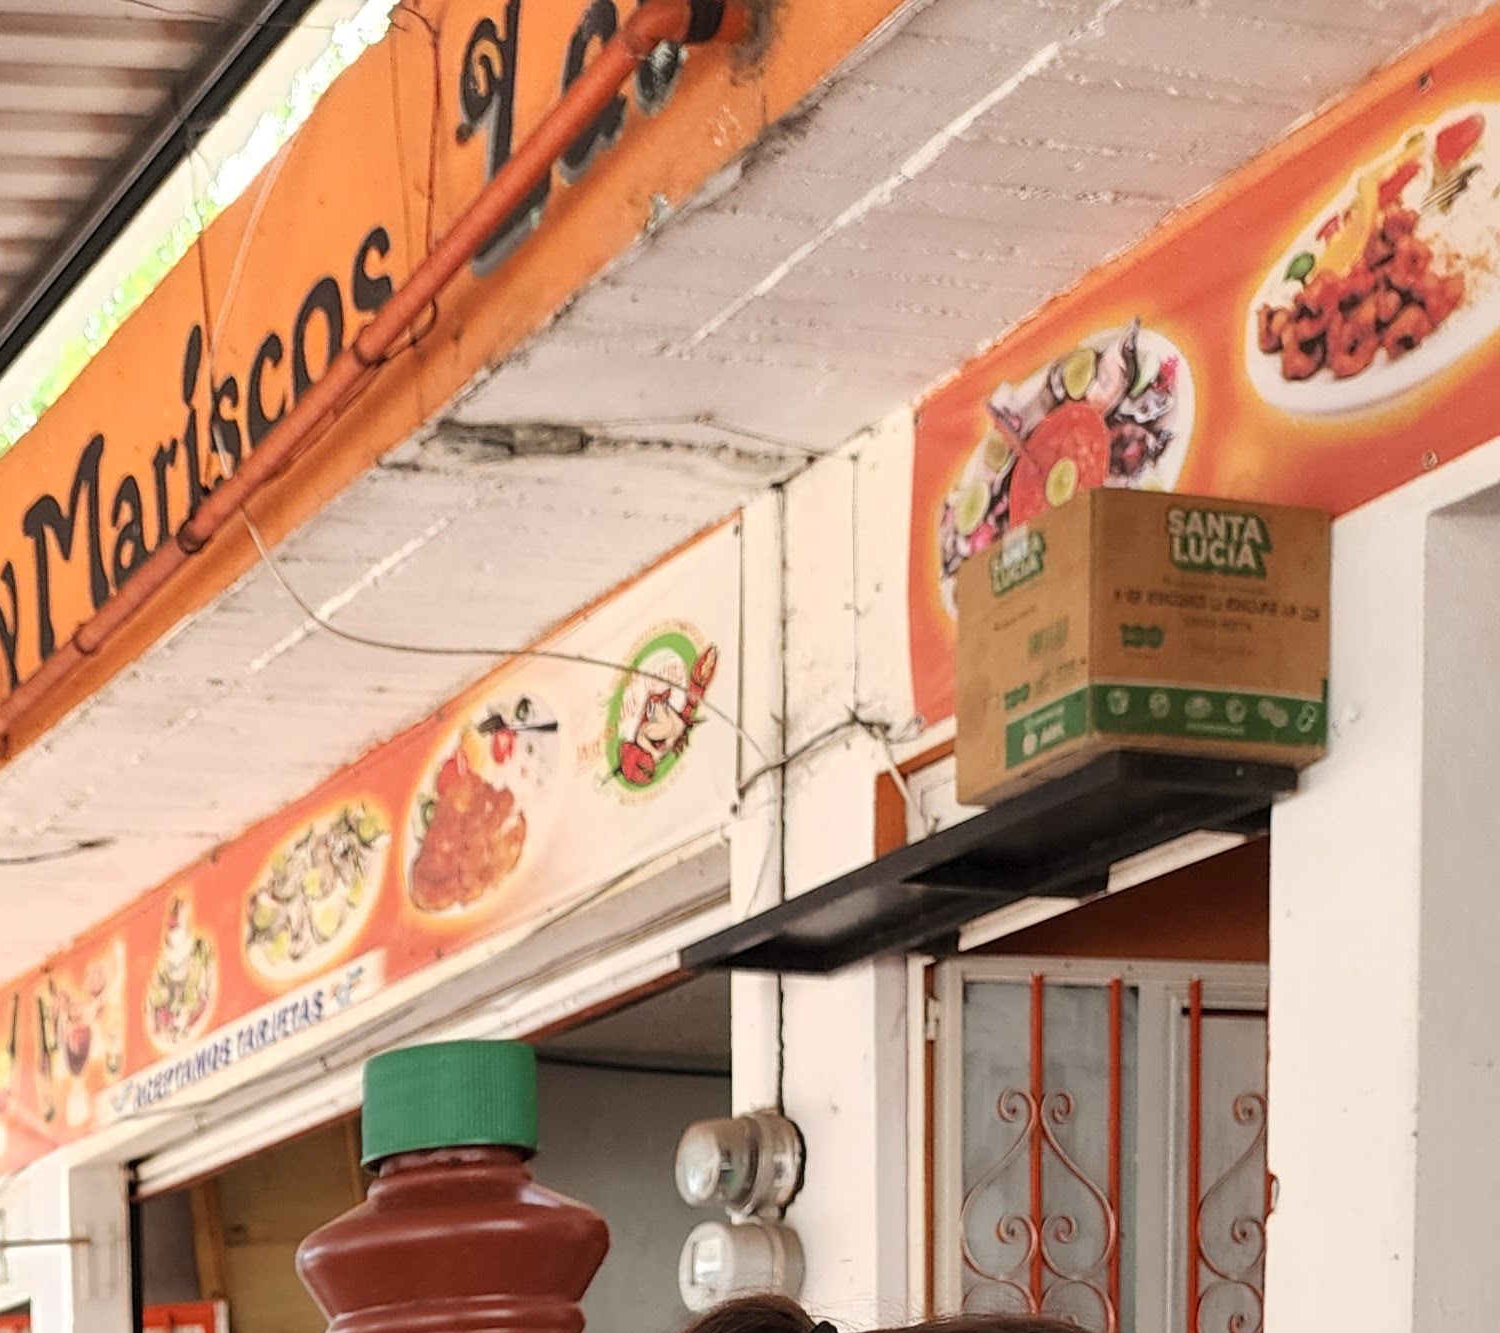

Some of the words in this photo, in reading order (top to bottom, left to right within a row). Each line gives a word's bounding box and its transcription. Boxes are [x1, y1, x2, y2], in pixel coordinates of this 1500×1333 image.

[22, 226, 396, 662] Mariscos
[1168, 508, 1264, 543] SANTA
[235, 989, 325, 1061] TARJETAS
